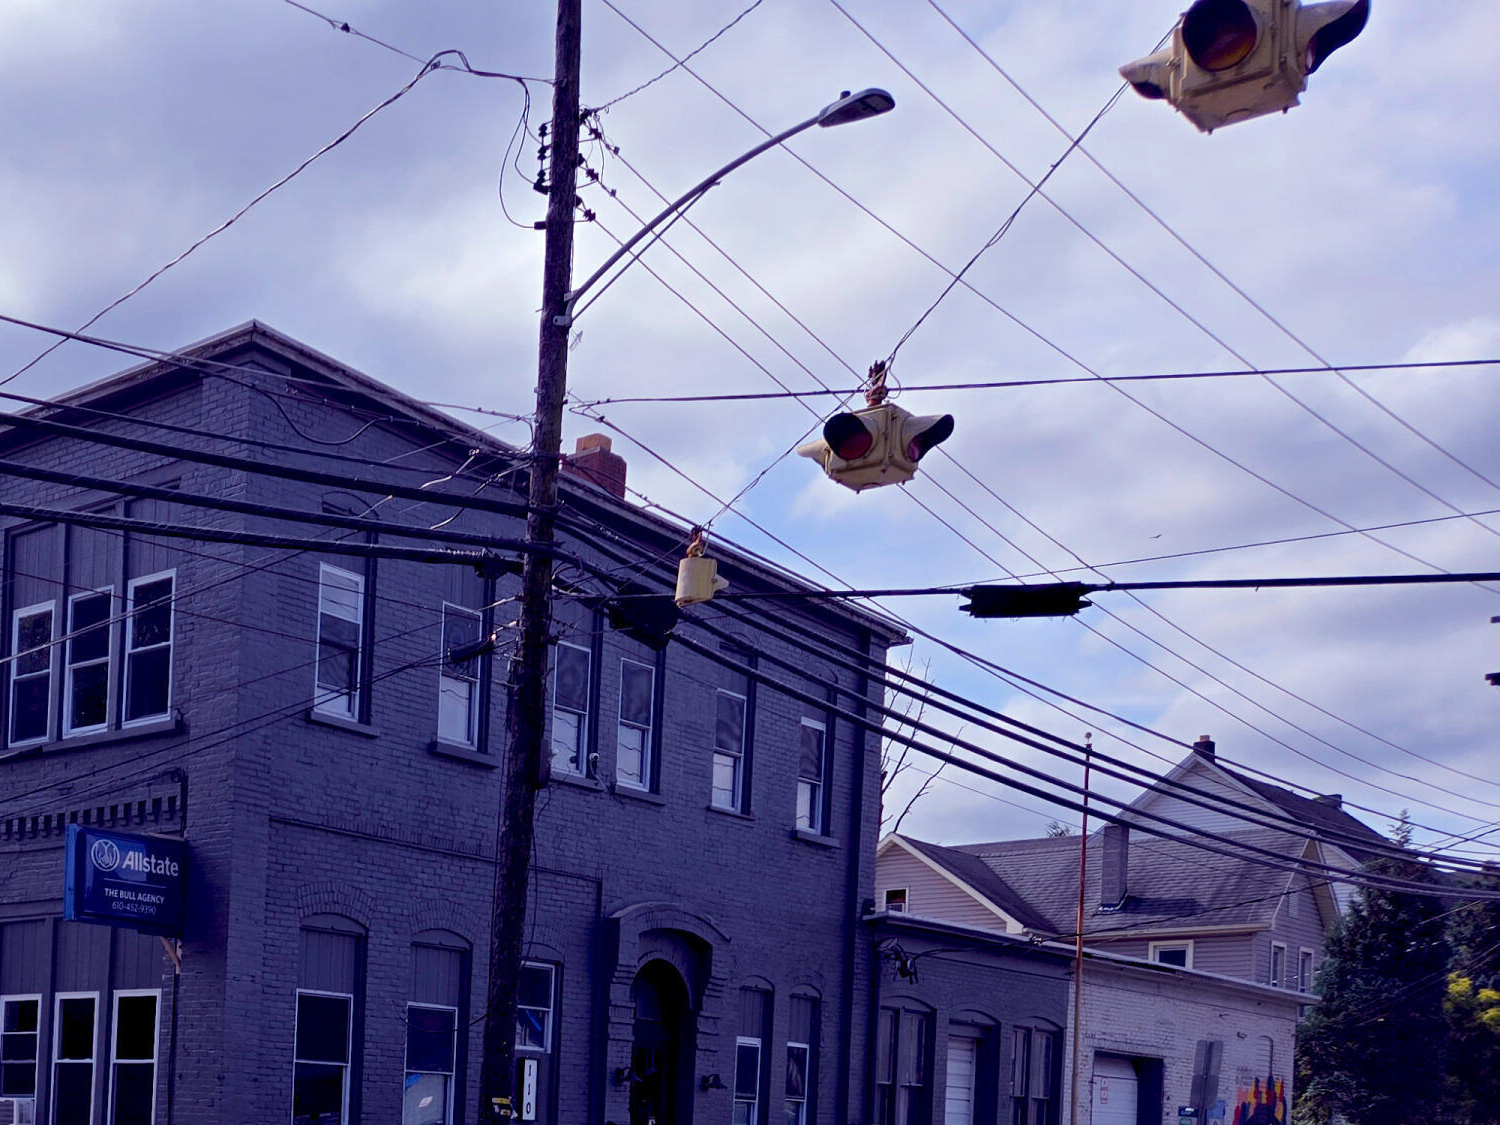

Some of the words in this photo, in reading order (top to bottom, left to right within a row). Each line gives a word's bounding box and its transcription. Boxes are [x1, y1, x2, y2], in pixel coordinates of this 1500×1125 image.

[122, 850, 179, 876] Allstate
[104, 888, 118, 897] THE
[120, 889, 136, 900] BULL
[137, 892, 164, 904] AGENCY
